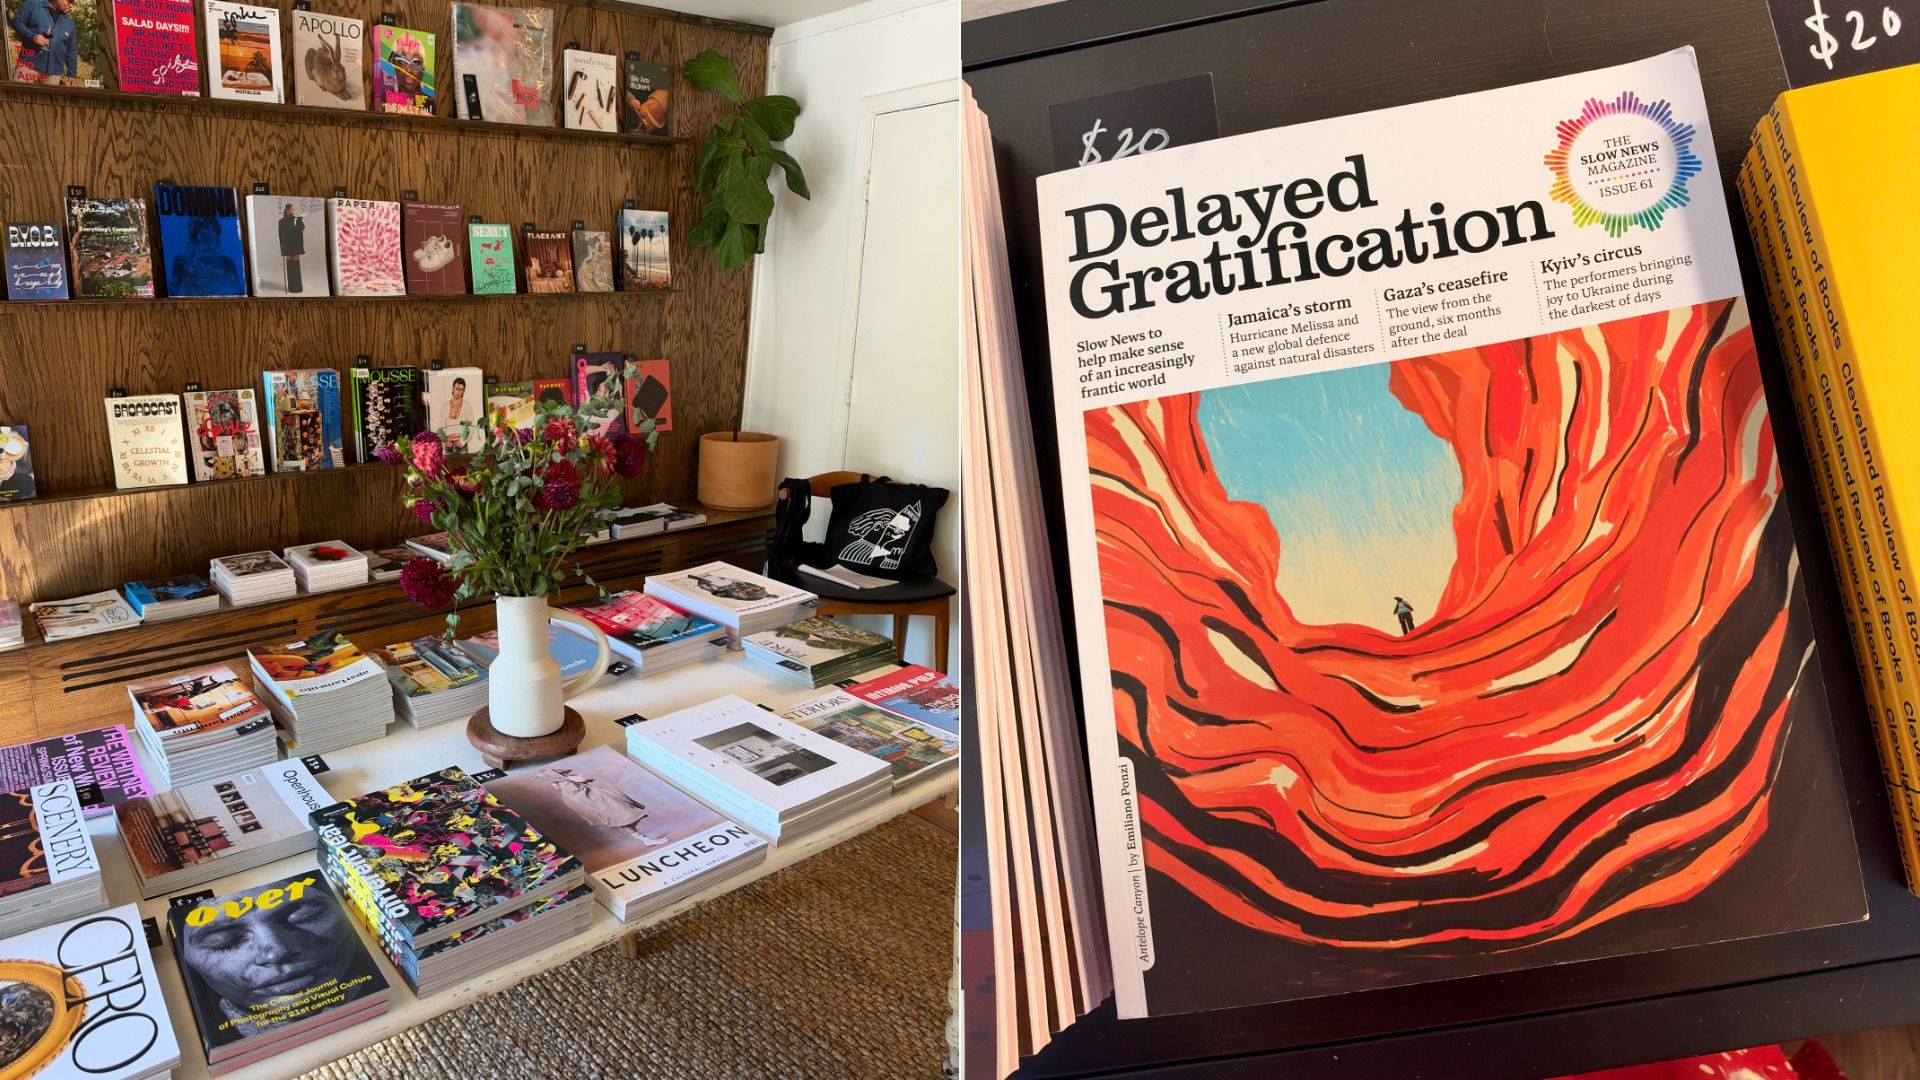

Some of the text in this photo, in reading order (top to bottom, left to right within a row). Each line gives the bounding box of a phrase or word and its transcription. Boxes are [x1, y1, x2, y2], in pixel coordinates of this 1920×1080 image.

[122, 17, 153, 29] SALAD
[299, 16, 360, 39] APOLLO
[1804, 0, 1901, 70] $20
[629, 74, 651, 83] We Are
[629, 82, 651, 92] Makers
[1078, 118, 1170, 168] $20
[1580, 141, 1660, 166] SLOW NEWS
[1603, 135, 1632, 149] THE
[1587, 153, 1657, 176] MAGAZINE
[1600, 178, 1653, 198] ISSUE 61
[338, 199, 375, 210] PAPER
[1065, 153, 1378, 261] Delayed
[472, 226, 509, 238] SENET
[527, 232, 567, 240] FLAGRANT
[1069, 199, 1555, 319] Gratification
[1594, 244, 1643, 264] circus
[1438, 268, 1509, 294] ceasefire
[1544, 253, 1692, 292] The performers bringing
[1304, 297, 1353, 315] storm
[1386, 291, 1492, 321] The view from the
[1545, 273, 1673, 309] joy to Ukraine during
[1549, 290, 1662, 321] the darkest of days
[1230, 313, 1359, 344] Hurricane Melissa and
[1389, 305, 1502, 336] ground, six months
[1076, 327, 1163, 353] Slow News to
[1232, 331, 1351, 358] a new global defence
[1391, 325, 1467, 350] after the deal
[1078, 340, 1184, 369] help make sense
[1079, 352, 1195, 383] of an increasingly
[1234, 342, 1375, 374] against natural disasters
[1081, 373, 1166, 399] frantic world
[1787, 164, 1913, 605] Review of Books Cleveland Review of
[114, 401, 178, 418] BROADCAST
[1769, 184, 1903, 683] Review of Books Cleveland Review of Books
[131, 447, 172, 455] CELESTIAL
[134, 459, 170, 468] GROWTH
[1752, 227, 1772, 297] Review
[1796, 402, 1826, 512] Cleveland
[1822, 512, 1846, 583] Review
[1849, 621, 1868, 689] Books
[1759, 210, 1782, 284] Review
[1781, 289, 1792, 311] of
[1788, 315, 1807, 381] Books
[1807, 393, 1840, 501] Cleveland
[1836, 507, 1860, 584] Review
[1857, 592, 1870, 616] of
[1864, 618, 1886, 690] Books
[62, 734, 83, 746] of
[66, 745, 86, 773] New
[87, 745, 120, 790] REVIEW
[102, 726, 147, 800] THE WHITNEY
[283, 770, 320, 811] Openhous
[38, 783, 93, 875] SCENERY
[601, 826, 750, 890] LUNCHEON
[1118, 764, 1150, 963] Antelope Canyon by Emiliano Ponzi
[185, 877, 317, 927] over
[57, 916, 160, 1074] CERO
[218, 975, 373, 1031] of Photography and Visual Culture
[251, 978, 338, 1012] The Critical Journal
[256, 994, 345, 1028] for the 21st century
